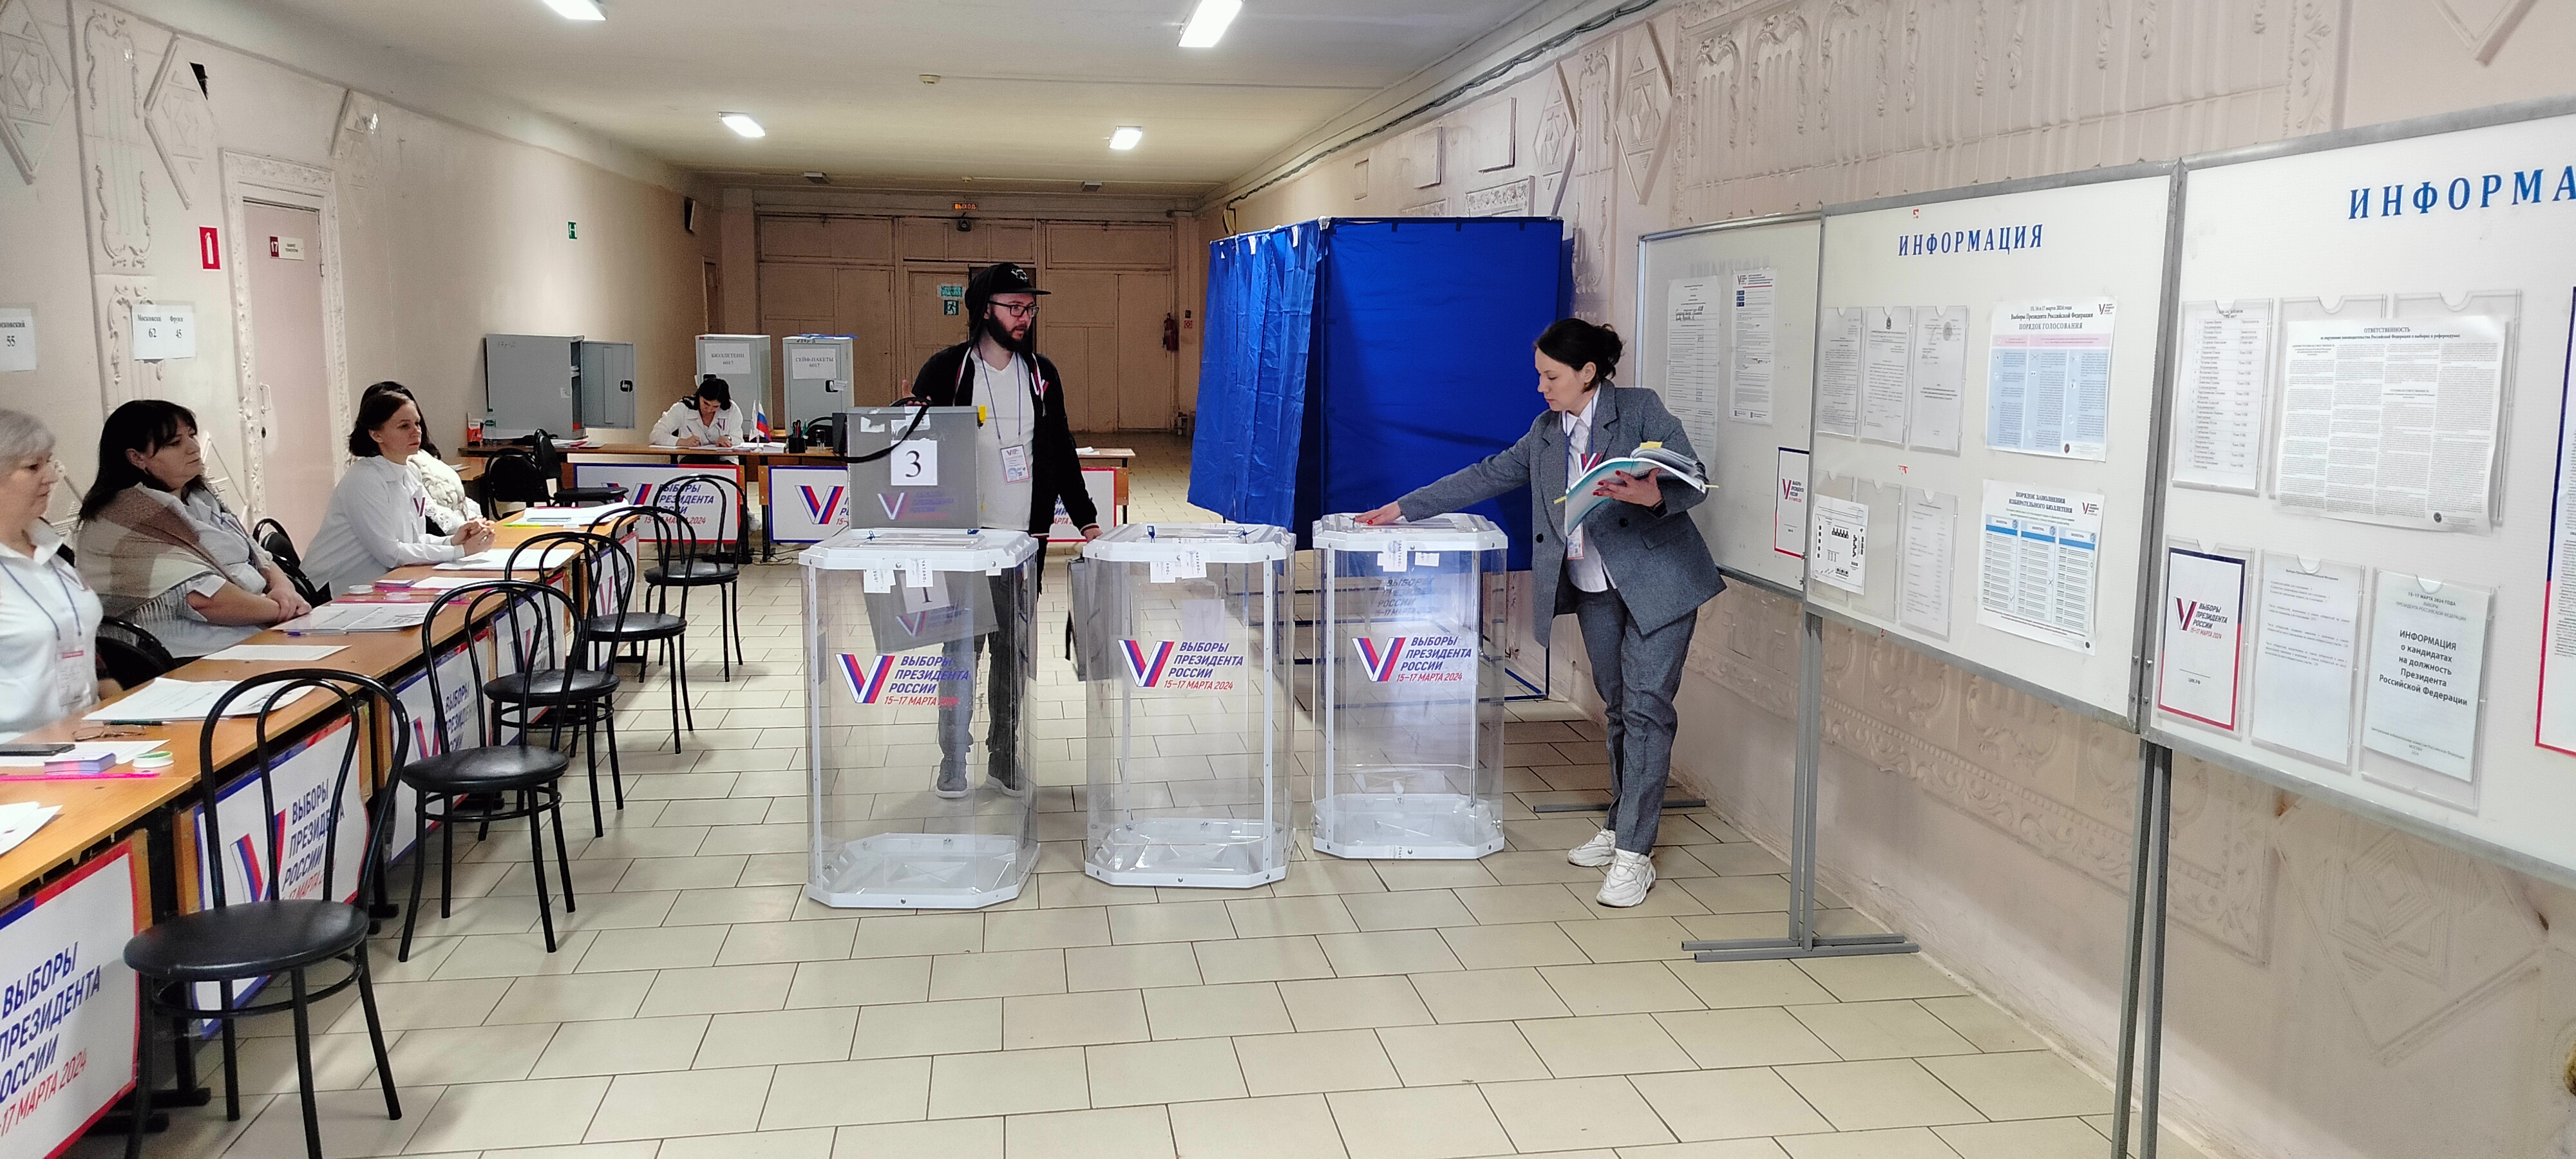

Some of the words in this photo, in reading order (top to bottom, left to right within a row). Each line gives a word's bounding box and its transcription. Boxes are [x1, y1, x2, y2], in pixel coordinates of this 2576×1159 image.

[2348, 165, 2576, 220] ИНФОРМА
[1899, 224, 2043, 256] ИНФОРМАЦИЯ
[271, 241, 278, 252] 17
[148, 328, 157, 339] 62
[176, 329, 182, 339] 45
[6, 335, 15, 347] 55
[905, 450, 922, 477] 3
[658, 495, 714, 505] РЕЗИДЕНТА
[2016, 491, 2035, 500] ПОРЯДОК
[2036, 495, 2065, 504] ЗАПОЛНЕНИЯ
[2009, 498, 2045, 509] ИЗБИРАТЕЛЬНОГО
[2046, 504, 2072, 513] БЮЛЛЕТЕНЯ
[2198, 603, 2222, 614] ВЫБОРЫ
[2396, 601, 2419, 610] ПРЕЗИДЕНТА
[2418, 607, 2443, 616] РОССИЙСКОЙ
[2444, 612, 2467, 621] ФЕДЕРАЦИИ
[2195, 610, 2228, 624] ПРЕЗИДЕНТА
[2193, 619, 2213, 629] РОССИИ
[2200, 629, 2212, 637] МАРТА
[1410, 636, 1458, 646] ВЫБОРЫ
[2399, 629, 2457, 651] ИНФОРМАЦИЯ
[1179, 641, 1229, 652] ВЫБОРЫ
[1405, 648, 1472, 659] ПРЕЗИДЕНТА
[2407, 646, 2452, 663] кандидатах
[900, 655, 953, 666] ВЫБОРЫ
[1173, 655, 1244, 667] ПРЕЗИДЕНТА
[1400, 661, 1443, 672] РОССИИ
[1168, 667, 1213, 678] РОССИИ
[2409, 659, 2452, 675] должность
[894, 669, 969, 681] ПРЕЗИДЕНТА
[1396, 674, 1417, 683] 15–17
[1417, 673, 1443, 682] МАРТА
[1444, 672, 1463, 681] 2024
[2400, 668, 2447, 687] Президента
[889, 683, 937, 693] РОССИИ
[1164, 680, 1186, 689] 15–17
[1186, 681, 1213, 690] МАРТА
[1214, 681, 1234, 690] 2024
[2379, 674, 2421, 693] Российской
[2422, 686, 2468, 706] Федерации
[446, 681, 470, 714] ВЫБОРЫ
[884, 696, 909, 704] 15–17
[909, 696, 937, 706] МАРТА
[292, 778, 329, 825] ВЫБОРЫ
[281, 843, 325, 892] РОССИИ
[2, 941, 79, 1020] ВЫБОРЫ
[0, 965, 101, 1062] ПРЕЗИДЕНТА
[0, 1033, 59, 1104] ОССИИ
[16, 1069, 59, 1125] МАРТА
[59, 1047, 87, 1090] 2024
